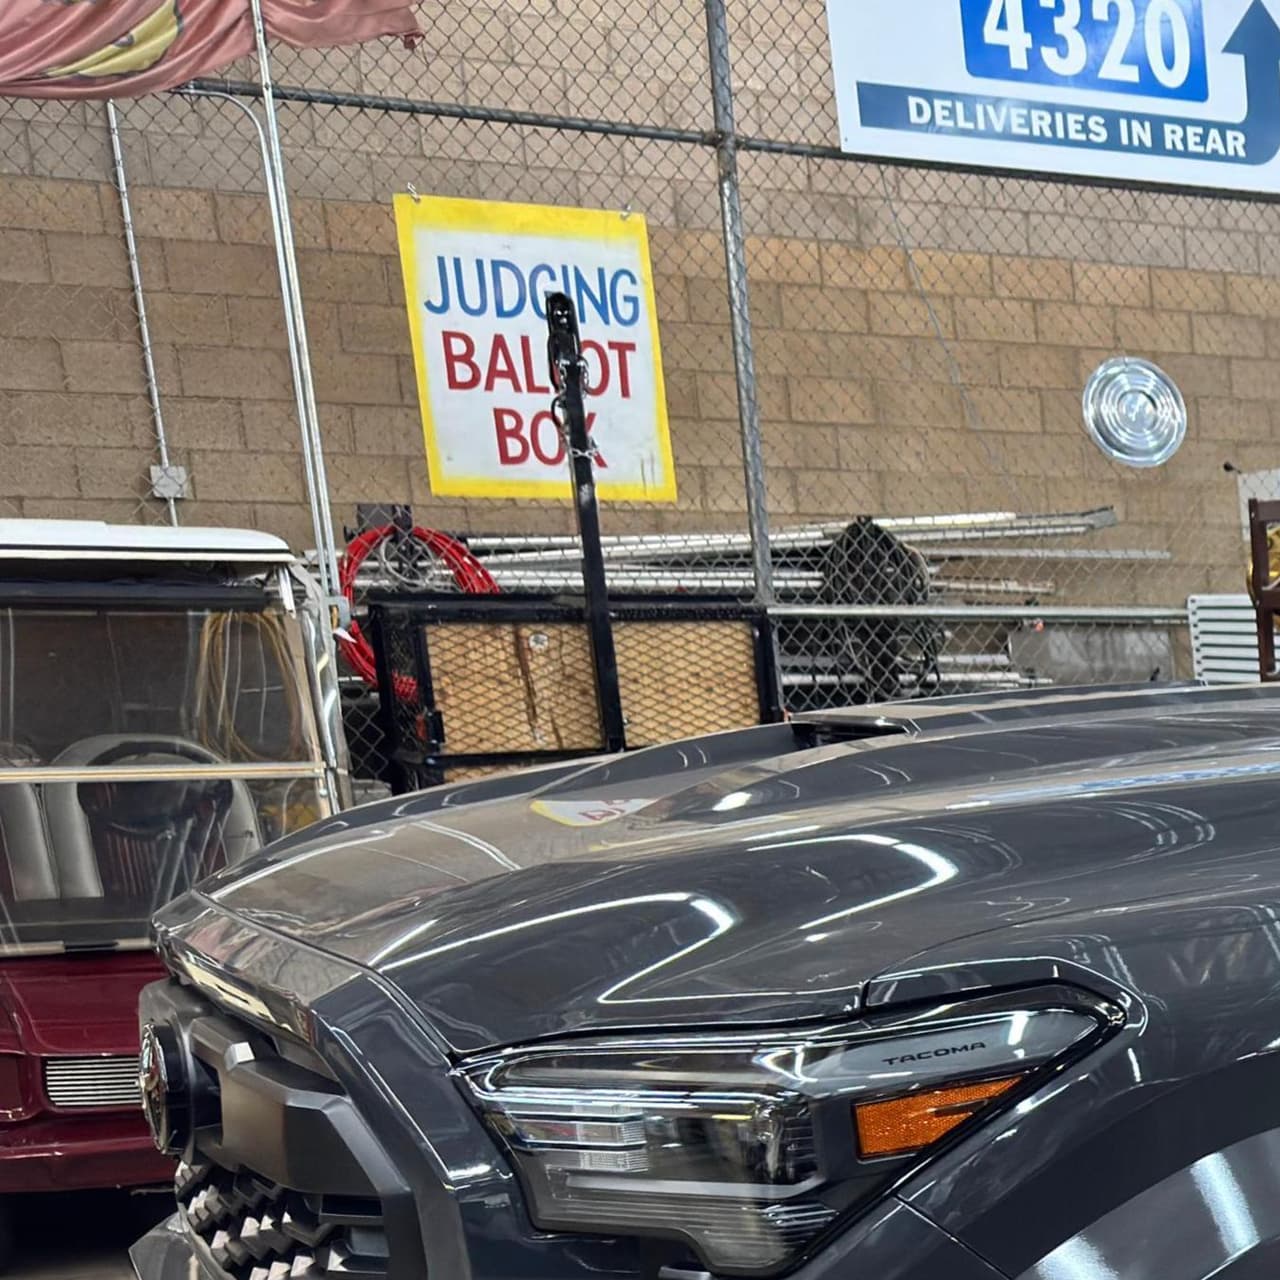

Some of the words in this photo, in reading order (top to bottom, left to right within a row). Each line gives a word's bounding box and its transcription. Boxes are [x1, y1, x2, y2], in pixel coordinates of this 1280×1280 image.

[983, 0, 1190, 88] 4320
[907, 96, 1108, 144] DELIVERIES
[1119, 118, 1152, 148] IN
[1163, 123, 1247, 158] REAR
[424, 256, 640, 327] JUDGING
[442, 330, 637, 399] BALOT
[882, 1041, 987, 1066] TACOMA
